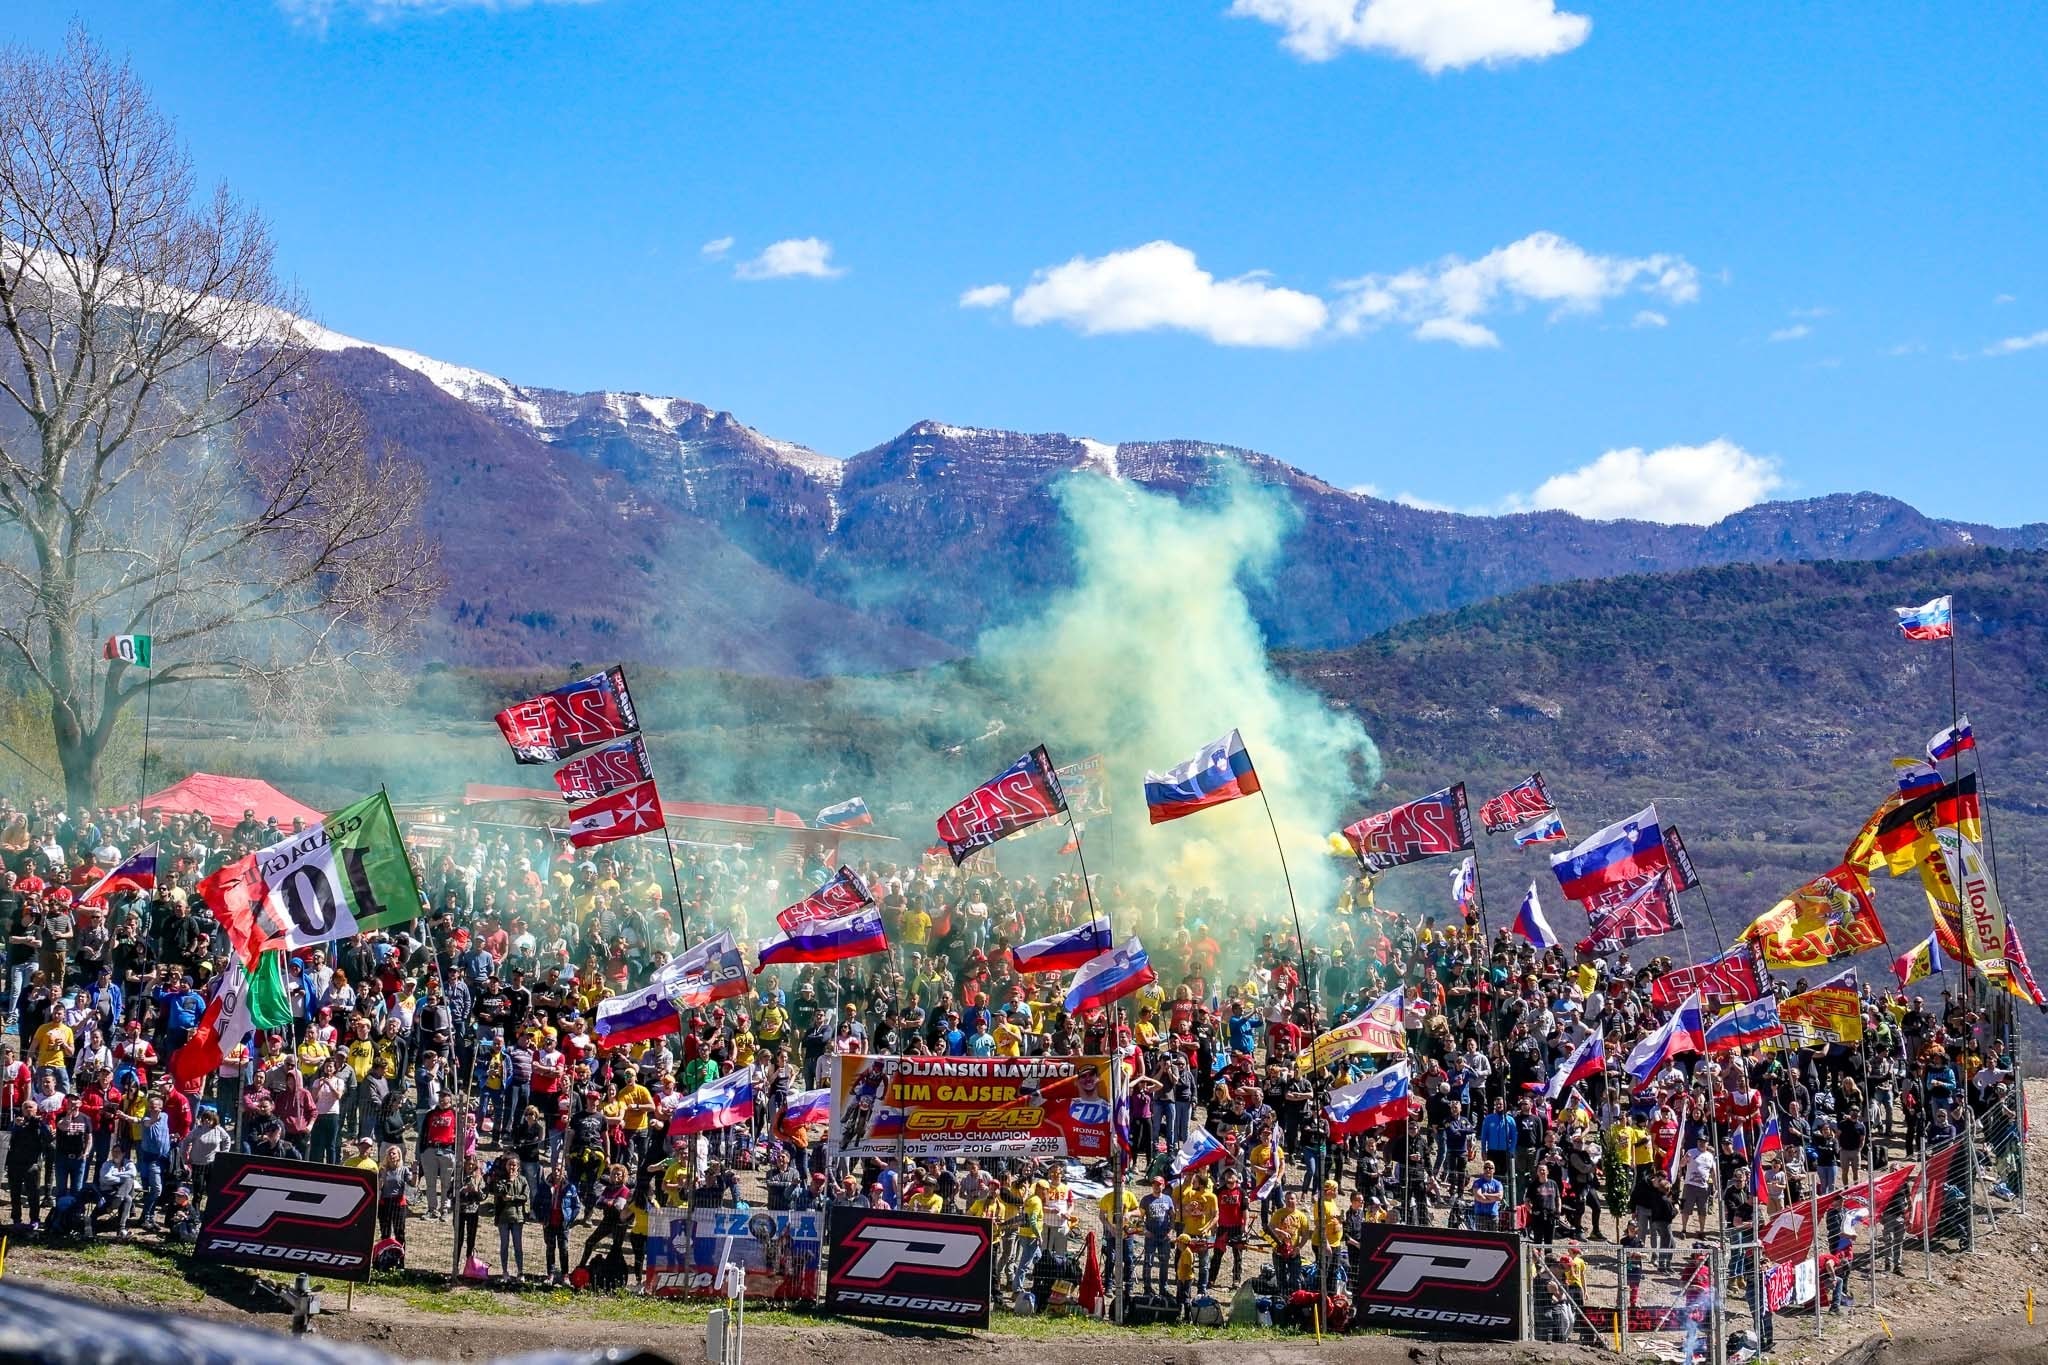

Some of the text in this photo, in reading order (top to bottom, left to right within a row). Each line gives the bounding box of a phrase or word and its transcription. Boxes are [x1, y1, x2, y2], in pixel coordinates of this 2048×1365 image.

[888, 1059, 1075, 1078] POLJANSKI NAVIJAČI
[892, 1085, 1016, 1101] TIM GAJSER
[921, 1131, 1031, 1141] WORLD CHAMPION
[1073, 1127, 1105, 1136] HONDA
[963, 1144, 992, 1153] 2016
[1031, 1144, 1059, 1152] 2019
[224, 1173, 366, 1228] P
[846, 1226, 982, 1279] P
[1377, 1241, 1509, 1292] P
